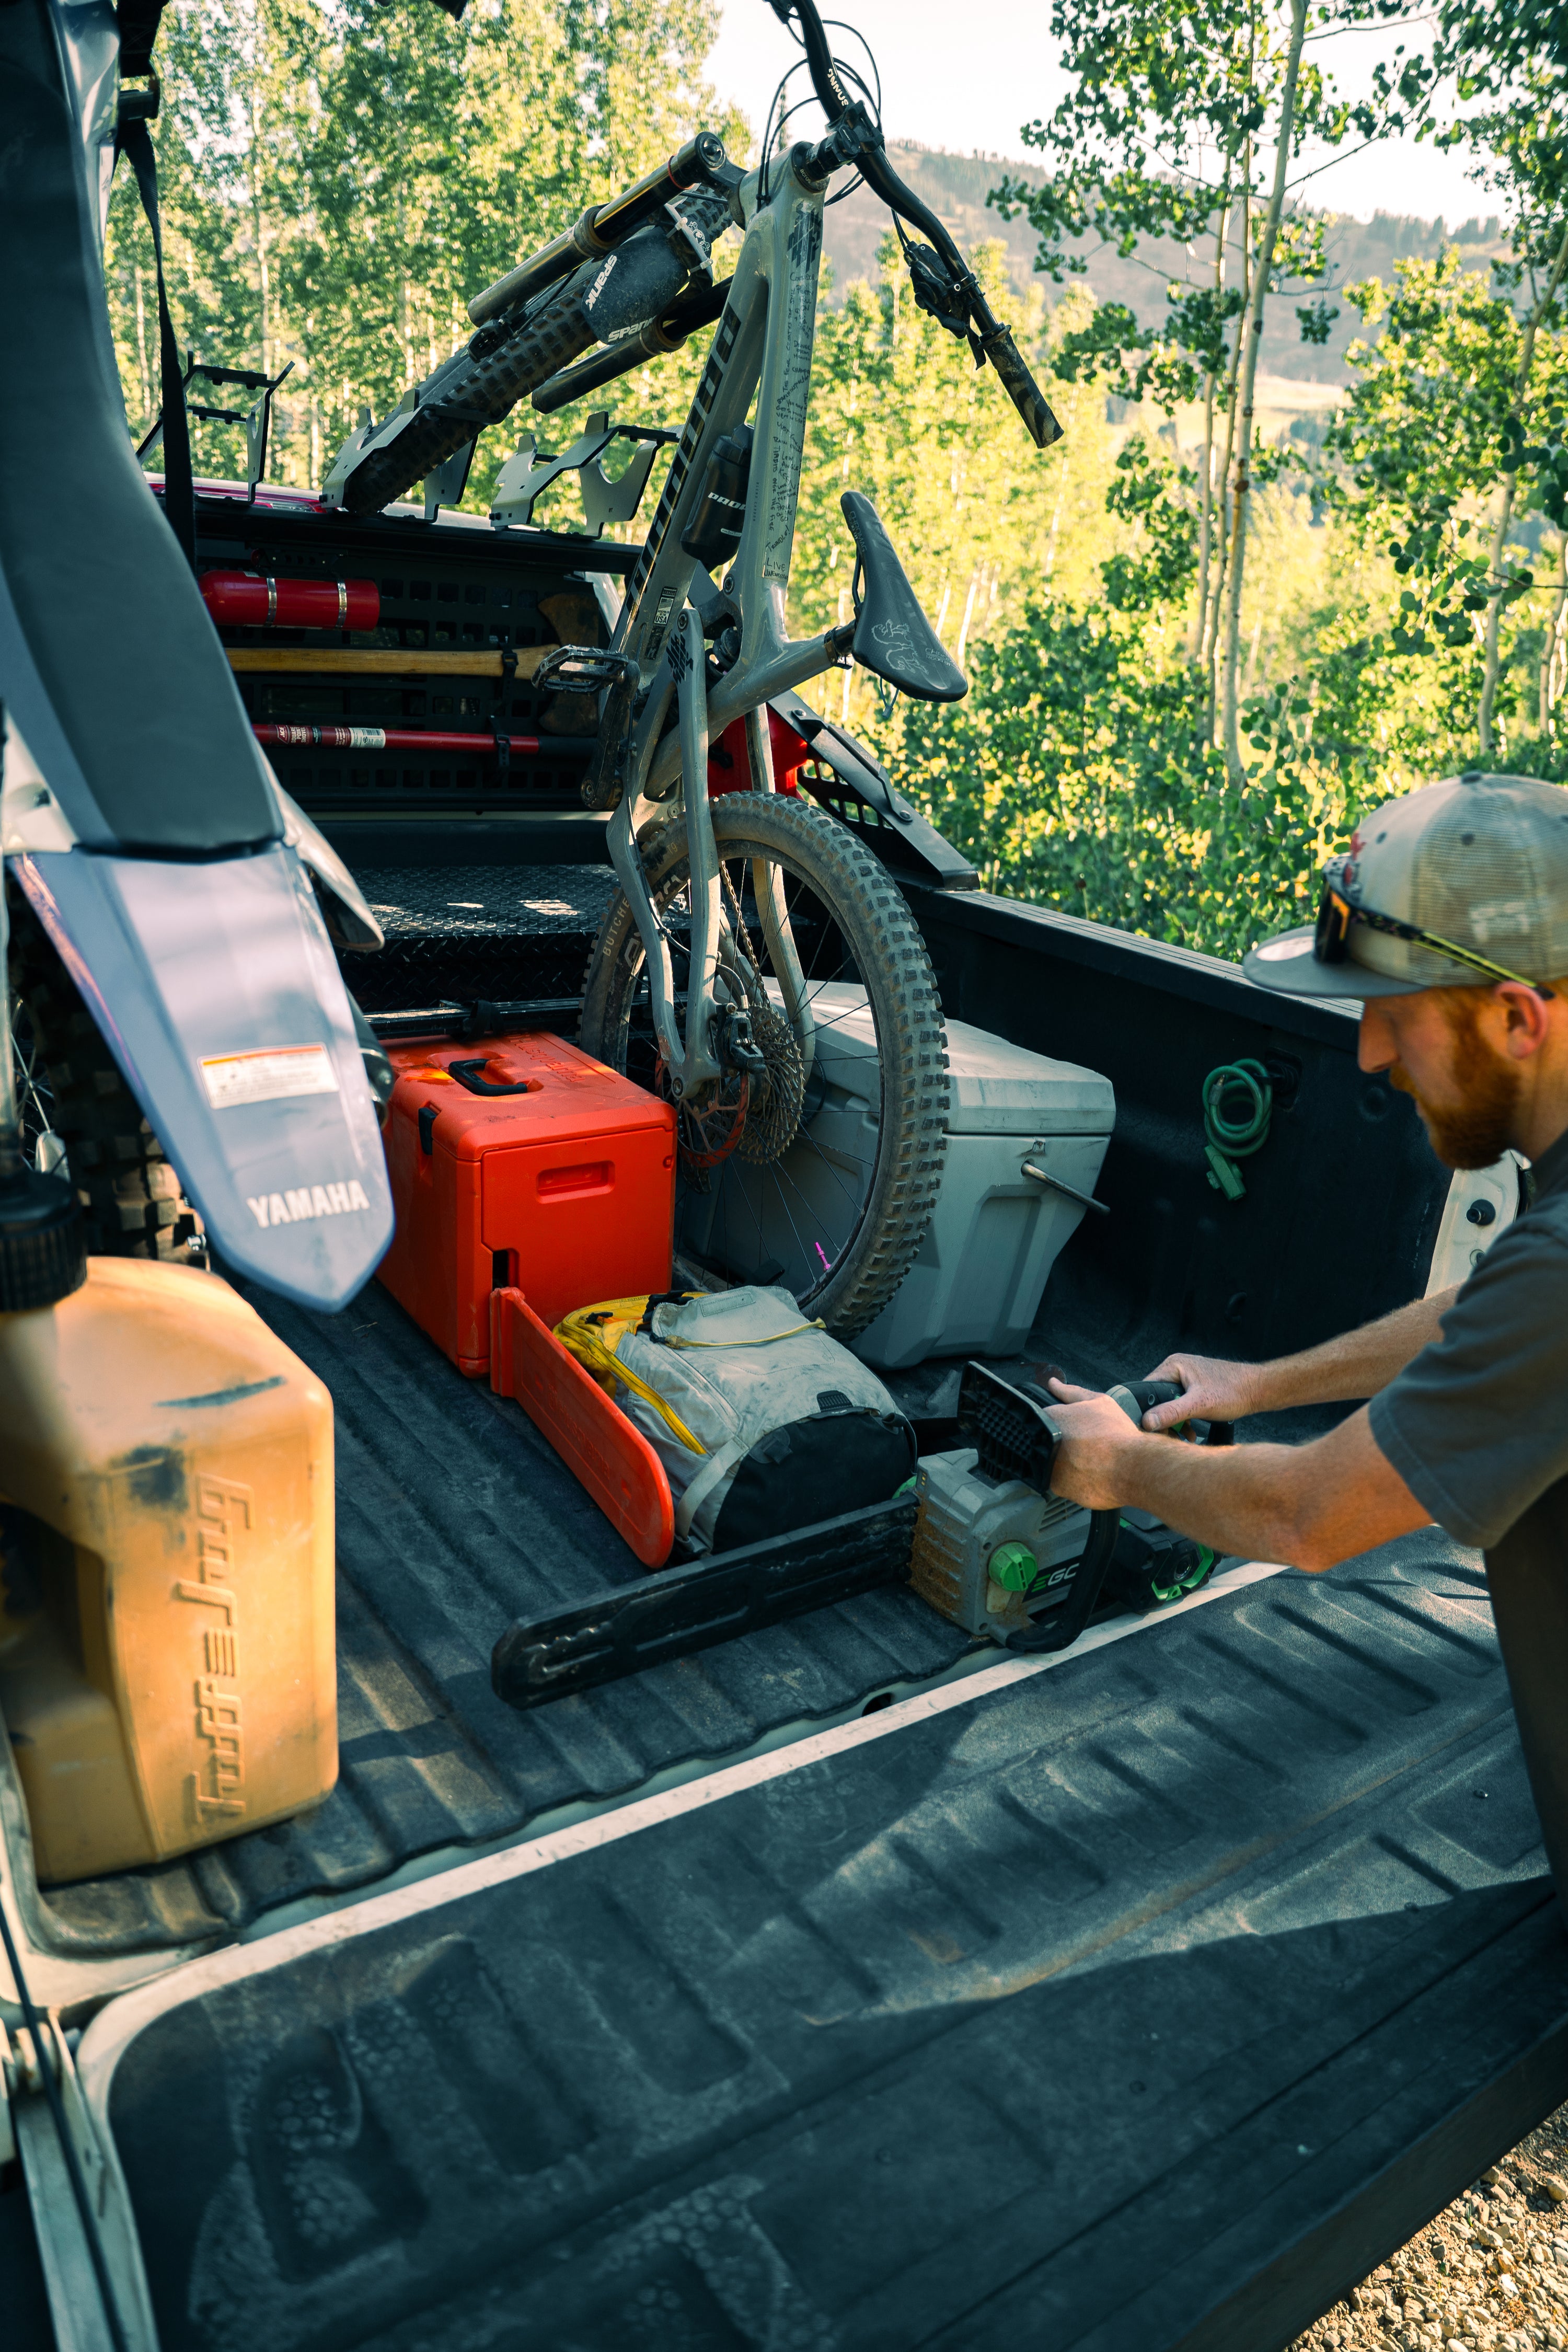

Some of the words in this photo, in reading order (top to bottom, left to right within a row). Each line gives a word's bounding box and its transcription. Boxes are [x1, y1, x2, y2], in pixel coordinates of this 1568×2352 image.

[800, 168, 811, 184] acros
[708, 492, 746, 510] PROP
[849, 511, 867, 552] CHROMAG
[767, 557, 786, 572] LIVE
[602, 897, 630, 956] BUTCHE
[246, 1179, 370, 1228] YAMAHA
[177, 1473, 255, 1626] Jug
[185, 1681, 246, 1824] Tuff
